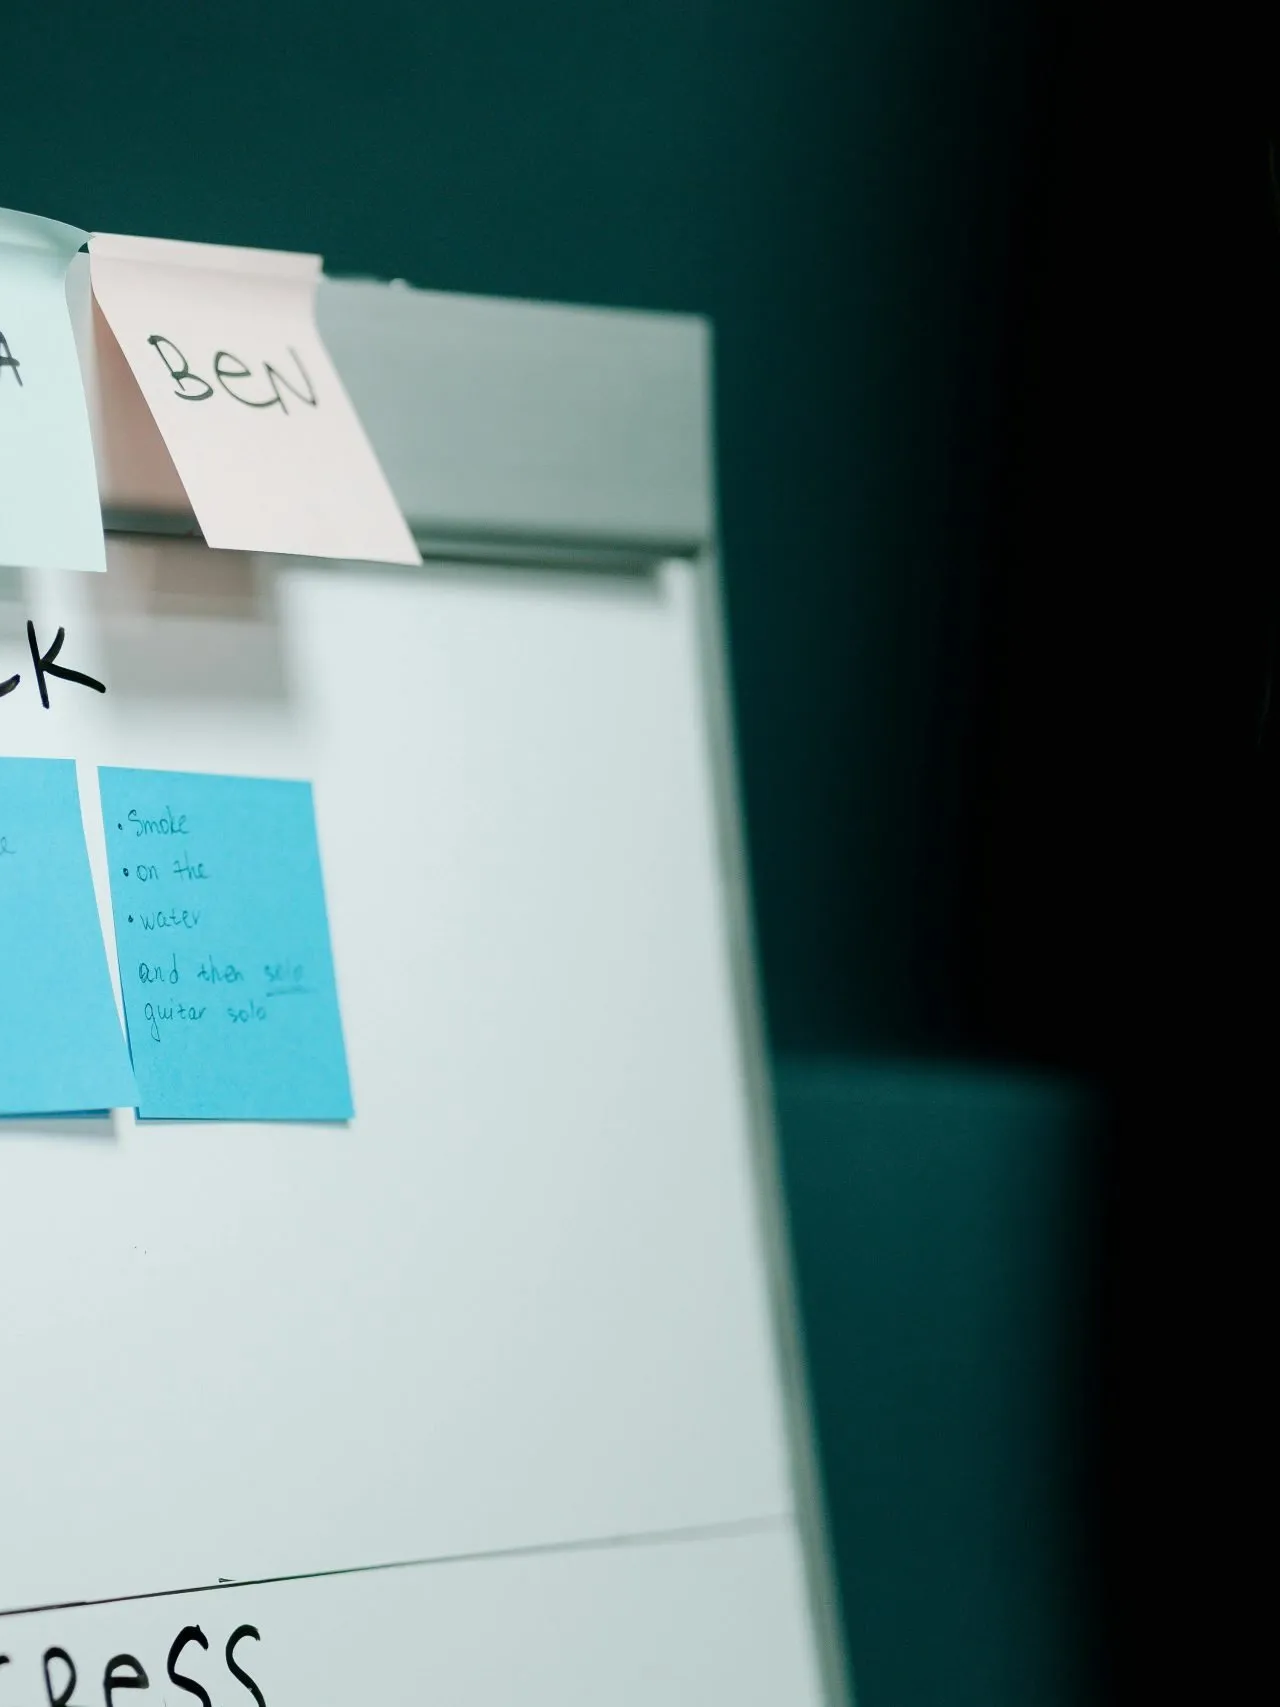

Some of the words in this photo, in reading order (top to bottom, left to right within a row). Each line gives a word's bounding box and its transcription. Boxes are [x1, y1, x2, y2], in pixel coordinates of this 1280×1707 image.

[127, 805, 190, 838] Smoke
[136, 863, 159, 883] on
[173, 851, 211, 881] the
[140, 911, 201, 931] water
[138, 952, 180, 985] and
[196, 954, 244, 985] then
[144, 1002, 207, 1043] guitar
[227, 1002, 267, 1023] solo
